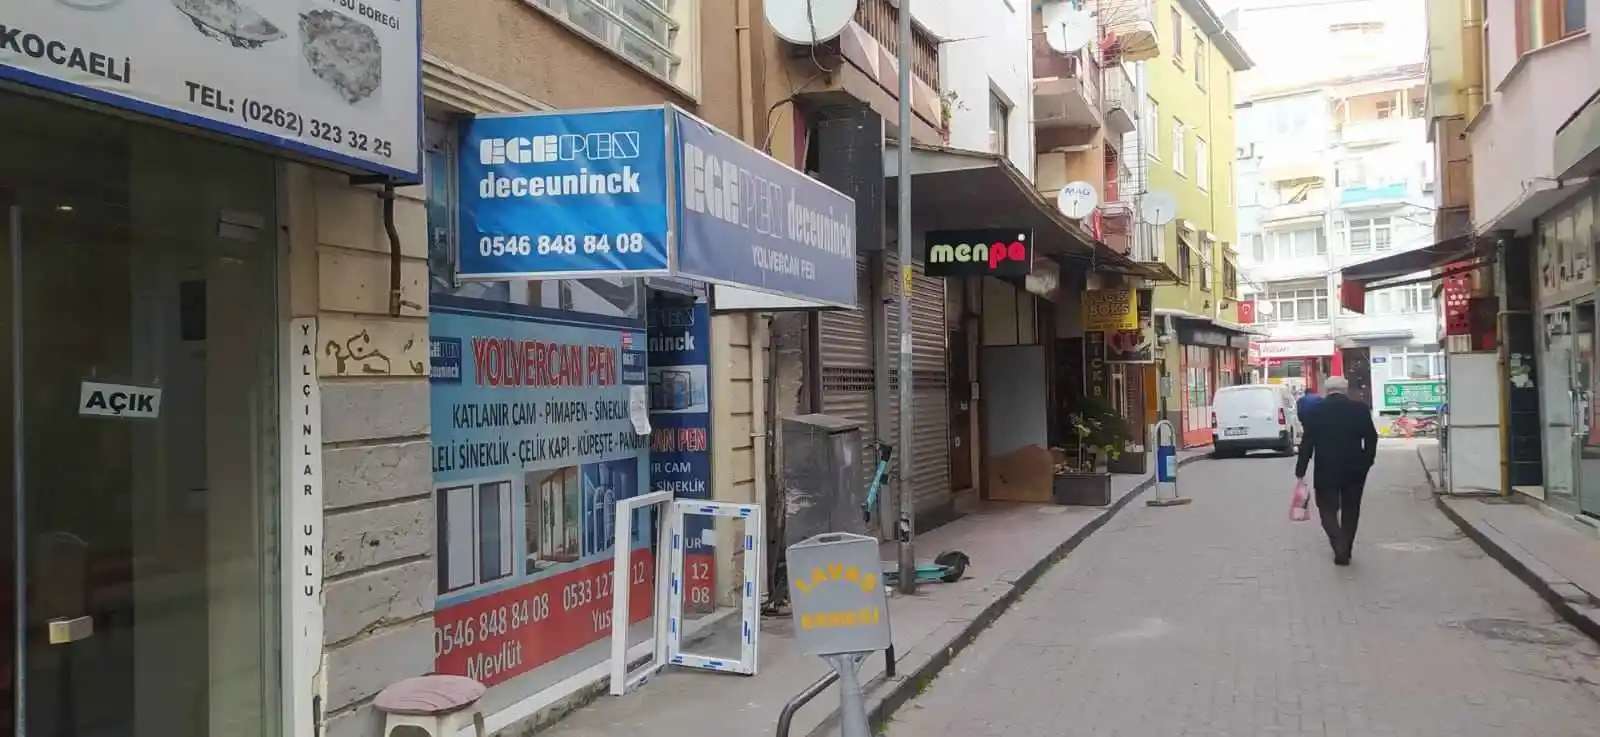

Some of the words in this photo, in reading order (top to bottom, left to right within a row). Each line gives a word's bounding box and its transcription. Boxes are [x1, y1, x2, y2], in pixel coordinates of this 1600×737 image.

[0, 24, 131, 84] KOCAELİ
[185, 80, 235, 114] TEL:
[242, 98, 304, 137] (0262)
[310, 118, 343, 144] 323
[348, 130, 369, 151] 32
[373, 138, 392, 158] 25
[480, 131, 639, 165] EGEPEN
[479, 166, 641, 198] deceuninck
[787, 186, 852, 260] deceuninck
[479, 235, 531, 257] 0546
[537, 234, 577, 255] 848
[583, 234, 611, 254] 84
[616, 232, 643, 254] 08
[752, 244, 800, 277] YOLVERCAN
[800, 258, 816, 281] PEN
[929, 239, 1026, 268] menpa
[472, 336, 583, 388] YOLVERCAN
[587, 344, 617, 386] PEN
[85, 391, 154, 414] AÇIK
[301, 324, 313, 496] YALÇINLAR
[453, 402, 509, 428] KATLANIR
[512, 402, 537, 426] CAM
[545, 398, 588, 424] PİMAPEN
[459, 436, 510, 469] SİNEKLİK
[519, 433, 546, 468] ÇELİK
[548, 436, 570, 460] KAPI
[577, 430, 613, 459] KÜPEŞTE
[677, 427, 707, 452] PEN
[664, 462, 691, 473] CAM
[303, 525, 314, 597] UNLU
[691, 563, 709, 580] 12
[563, 579, 592, 611] 0533
[632, 562, 645, 585] 12
[691, 587, 710, 604] 08
[434, 616, 475, 657] 0546
[479, 606, 507, 641] 848
[511, 600, 529, 629] 84
[532, 593, 549, 622] 08
[467, 639, 523, 681] Mevlüt
